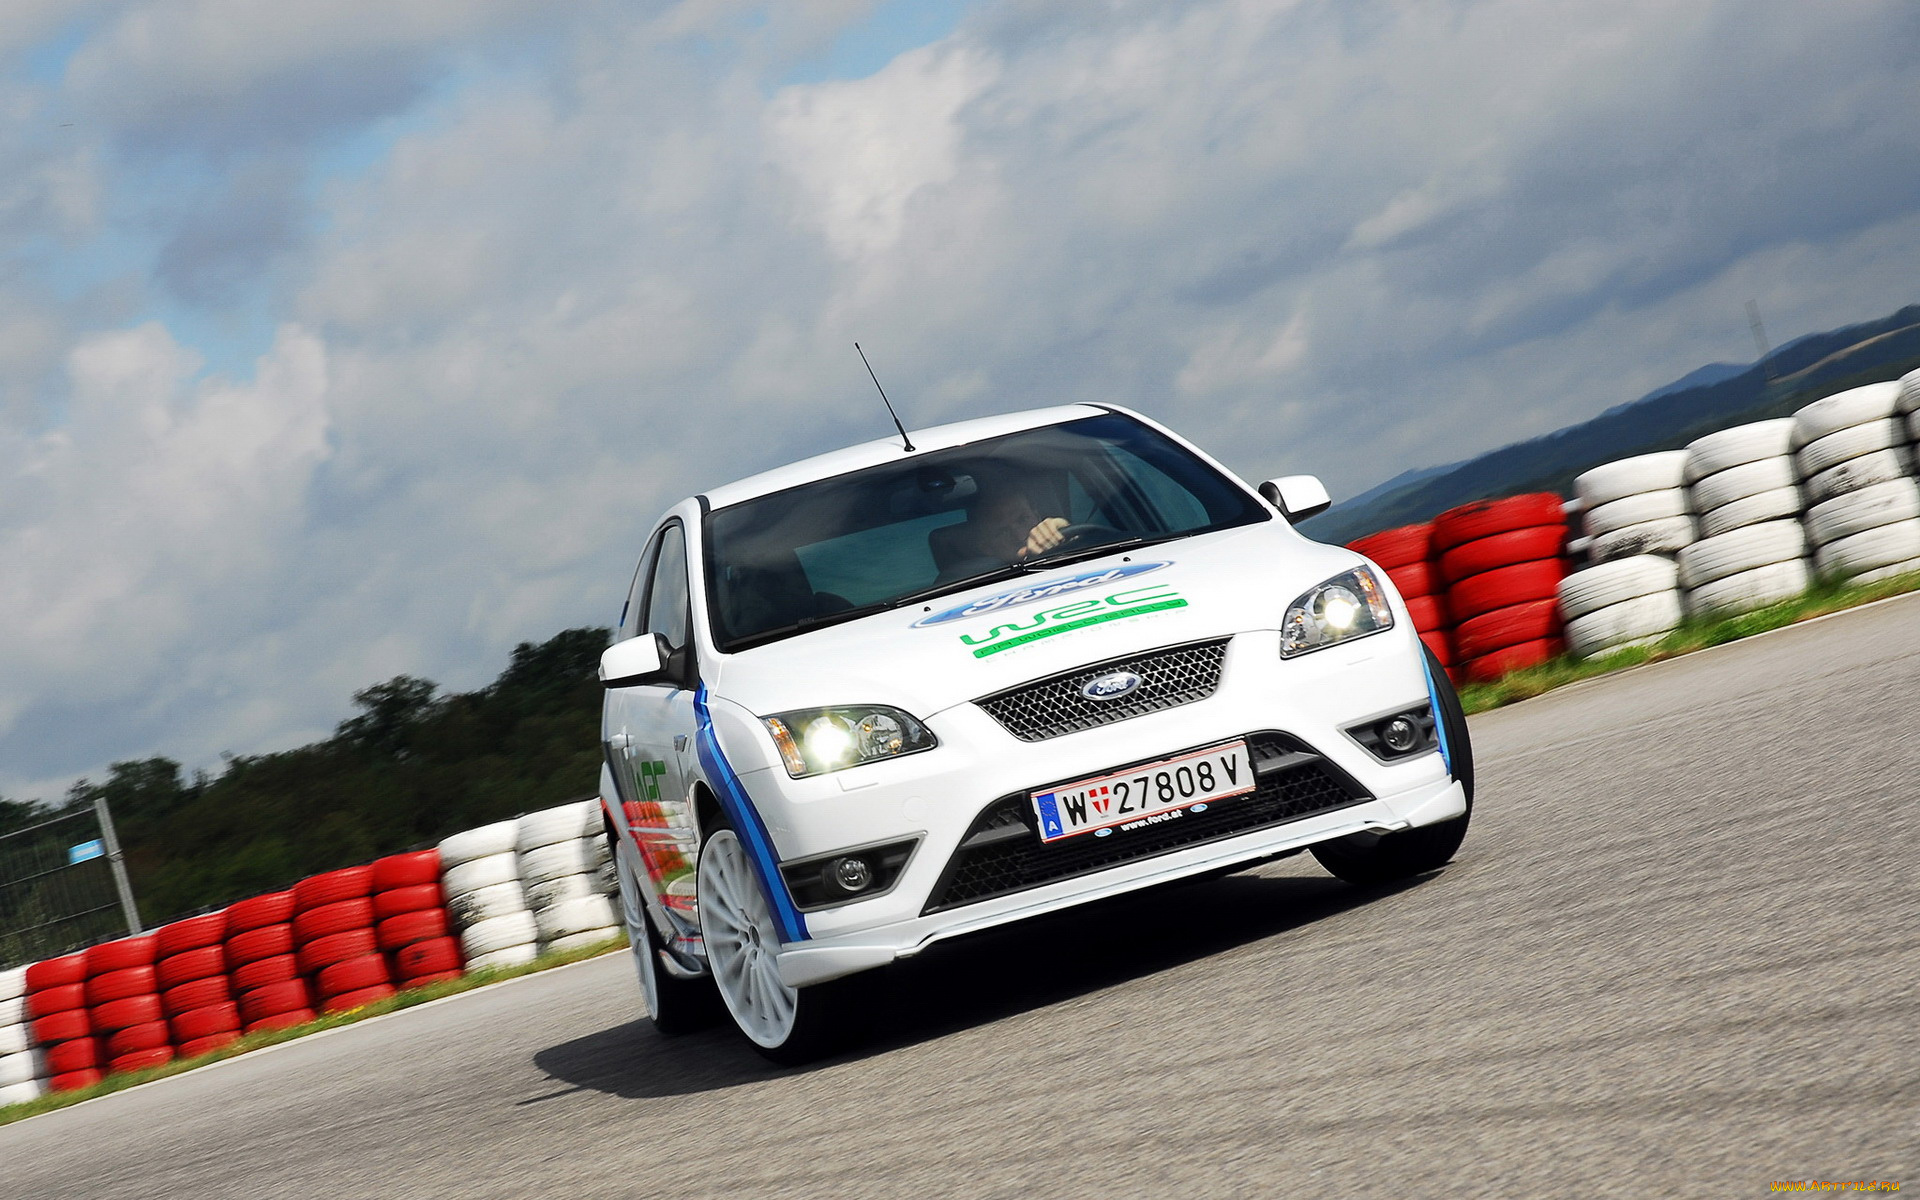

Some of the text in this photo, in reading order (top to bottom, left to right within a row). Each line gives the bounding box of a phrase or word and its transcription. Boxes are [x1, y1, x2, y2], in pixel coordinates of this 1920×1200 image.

[962, 569, 1123, 617] Ford
[959, 584, 1179, 645] WRC
[1018, 617, 1098, 643] WORLD
[1105, 601, 1182, 620] RALLY
[1096, 676, 1130, 695] Ford
[1063, 753, 1236, 826] W 27808 V
[1048, 820, 1059, 832] A
[1120, 809, 1183, 831] www.ford.at
